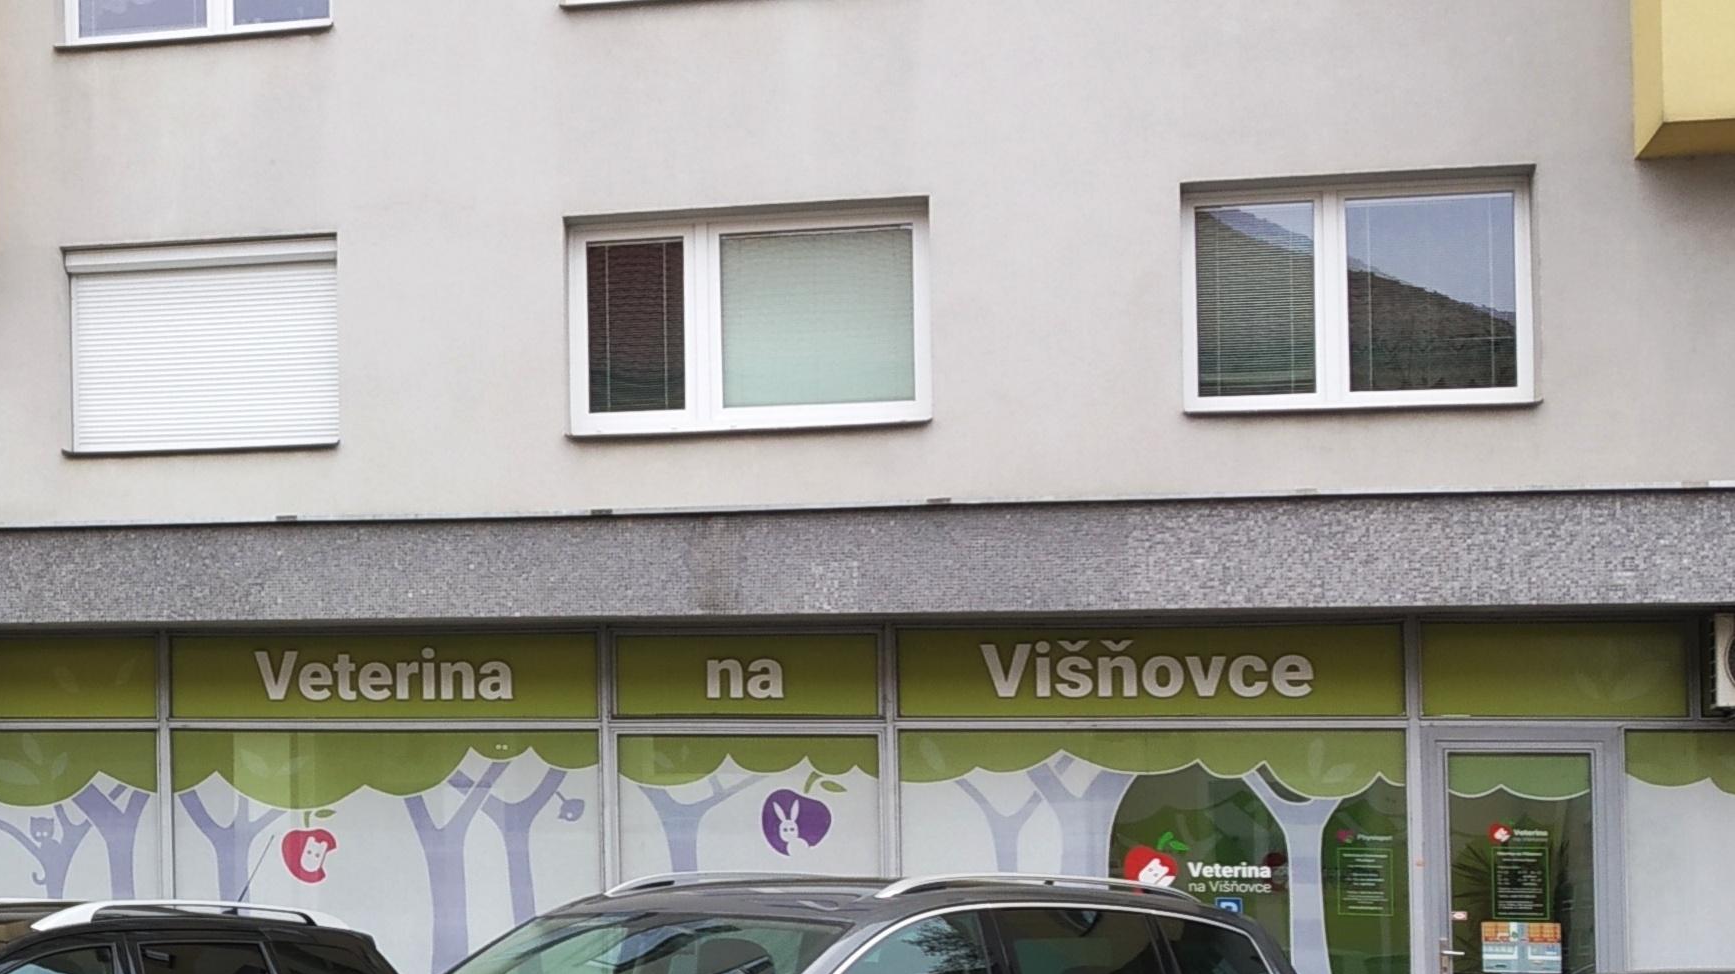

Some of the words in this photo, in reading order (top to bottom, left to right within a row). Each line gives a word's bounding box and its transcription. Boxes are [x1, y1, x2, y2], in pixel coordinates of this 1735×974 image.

[254, 647, 514, 701] Veterina
[706, 658, 785, 699] na
[979, 639, 1315, 699] Višňovce
[1187, 861, 1272, 878] Veterina
[1188, 882, 1206, 893] na
[1208, 880, 1272, 893] Višňovce
